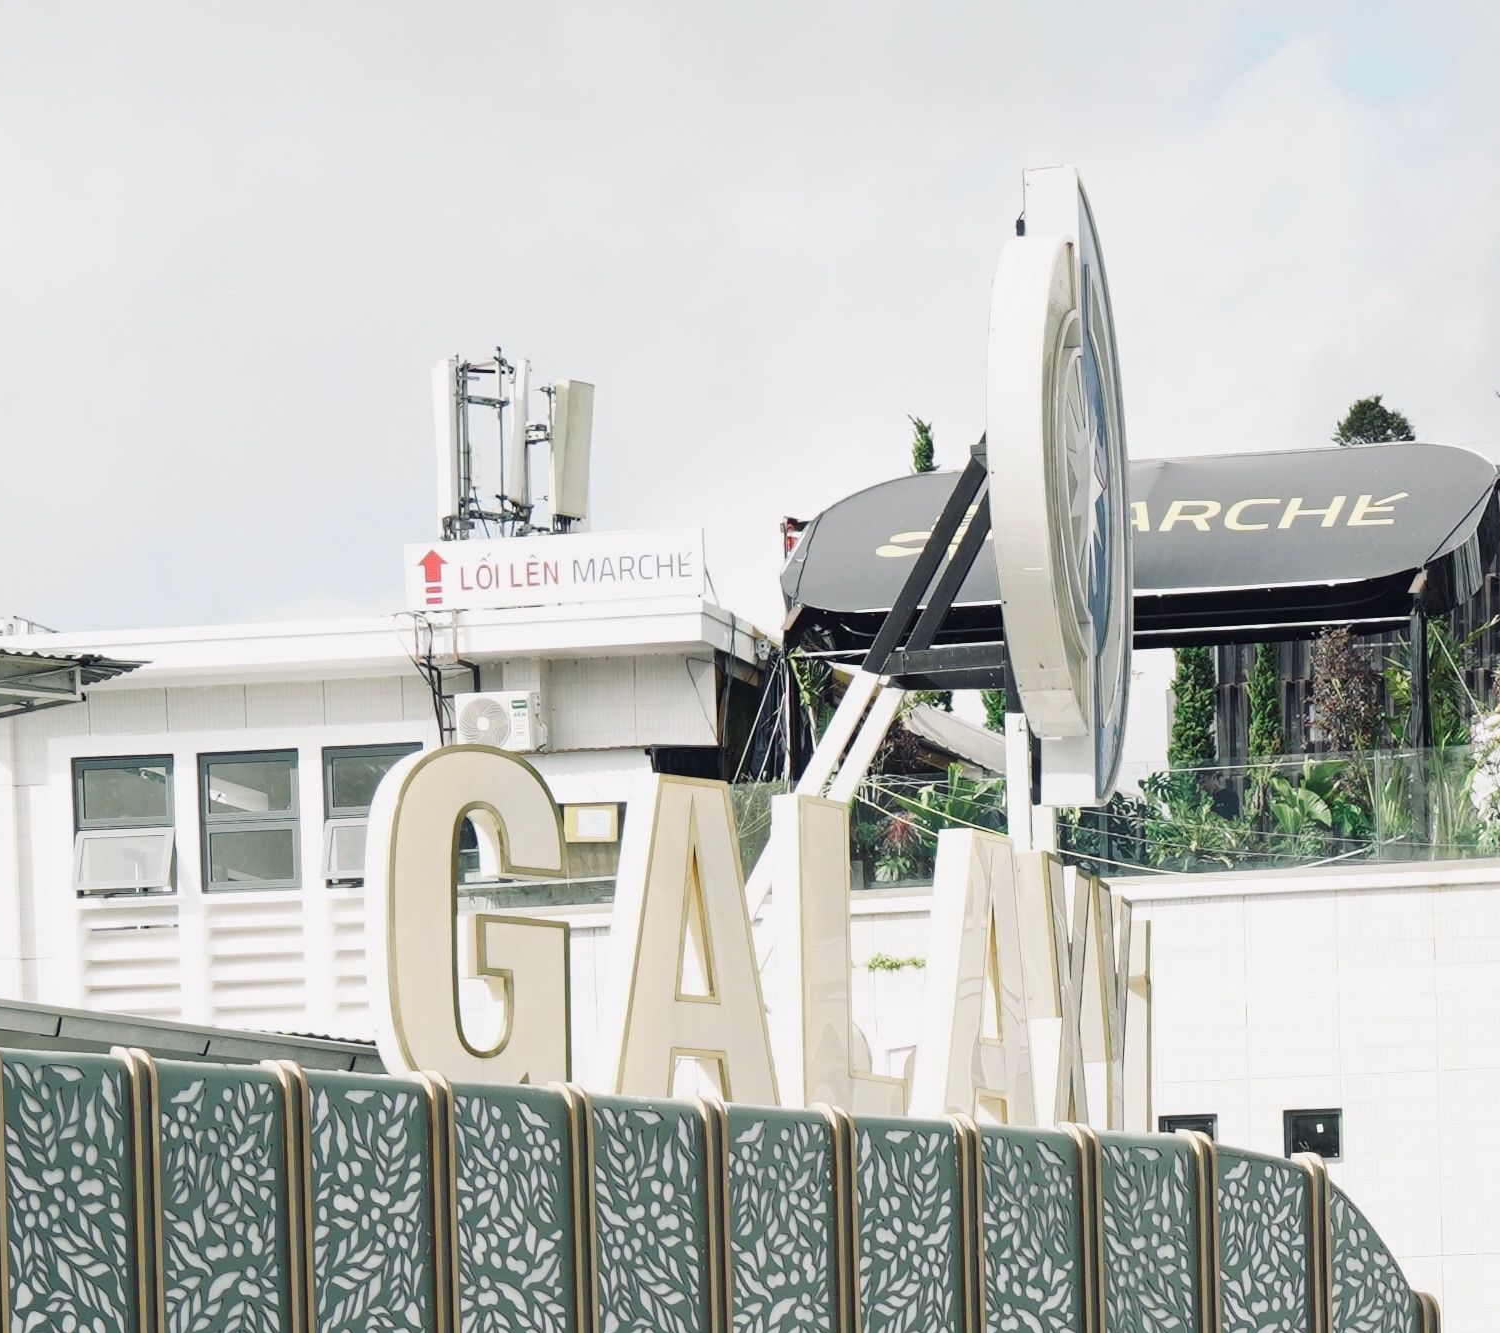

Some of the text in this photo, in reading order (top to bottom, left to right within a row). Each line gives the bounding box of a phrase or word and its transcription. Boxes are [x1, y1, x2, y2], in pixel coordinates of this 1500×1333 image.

[1129, 492, 1410, 533] ARCHÉ
[459, 551, 694, 591] LỐI LÊN MARCHÉ
